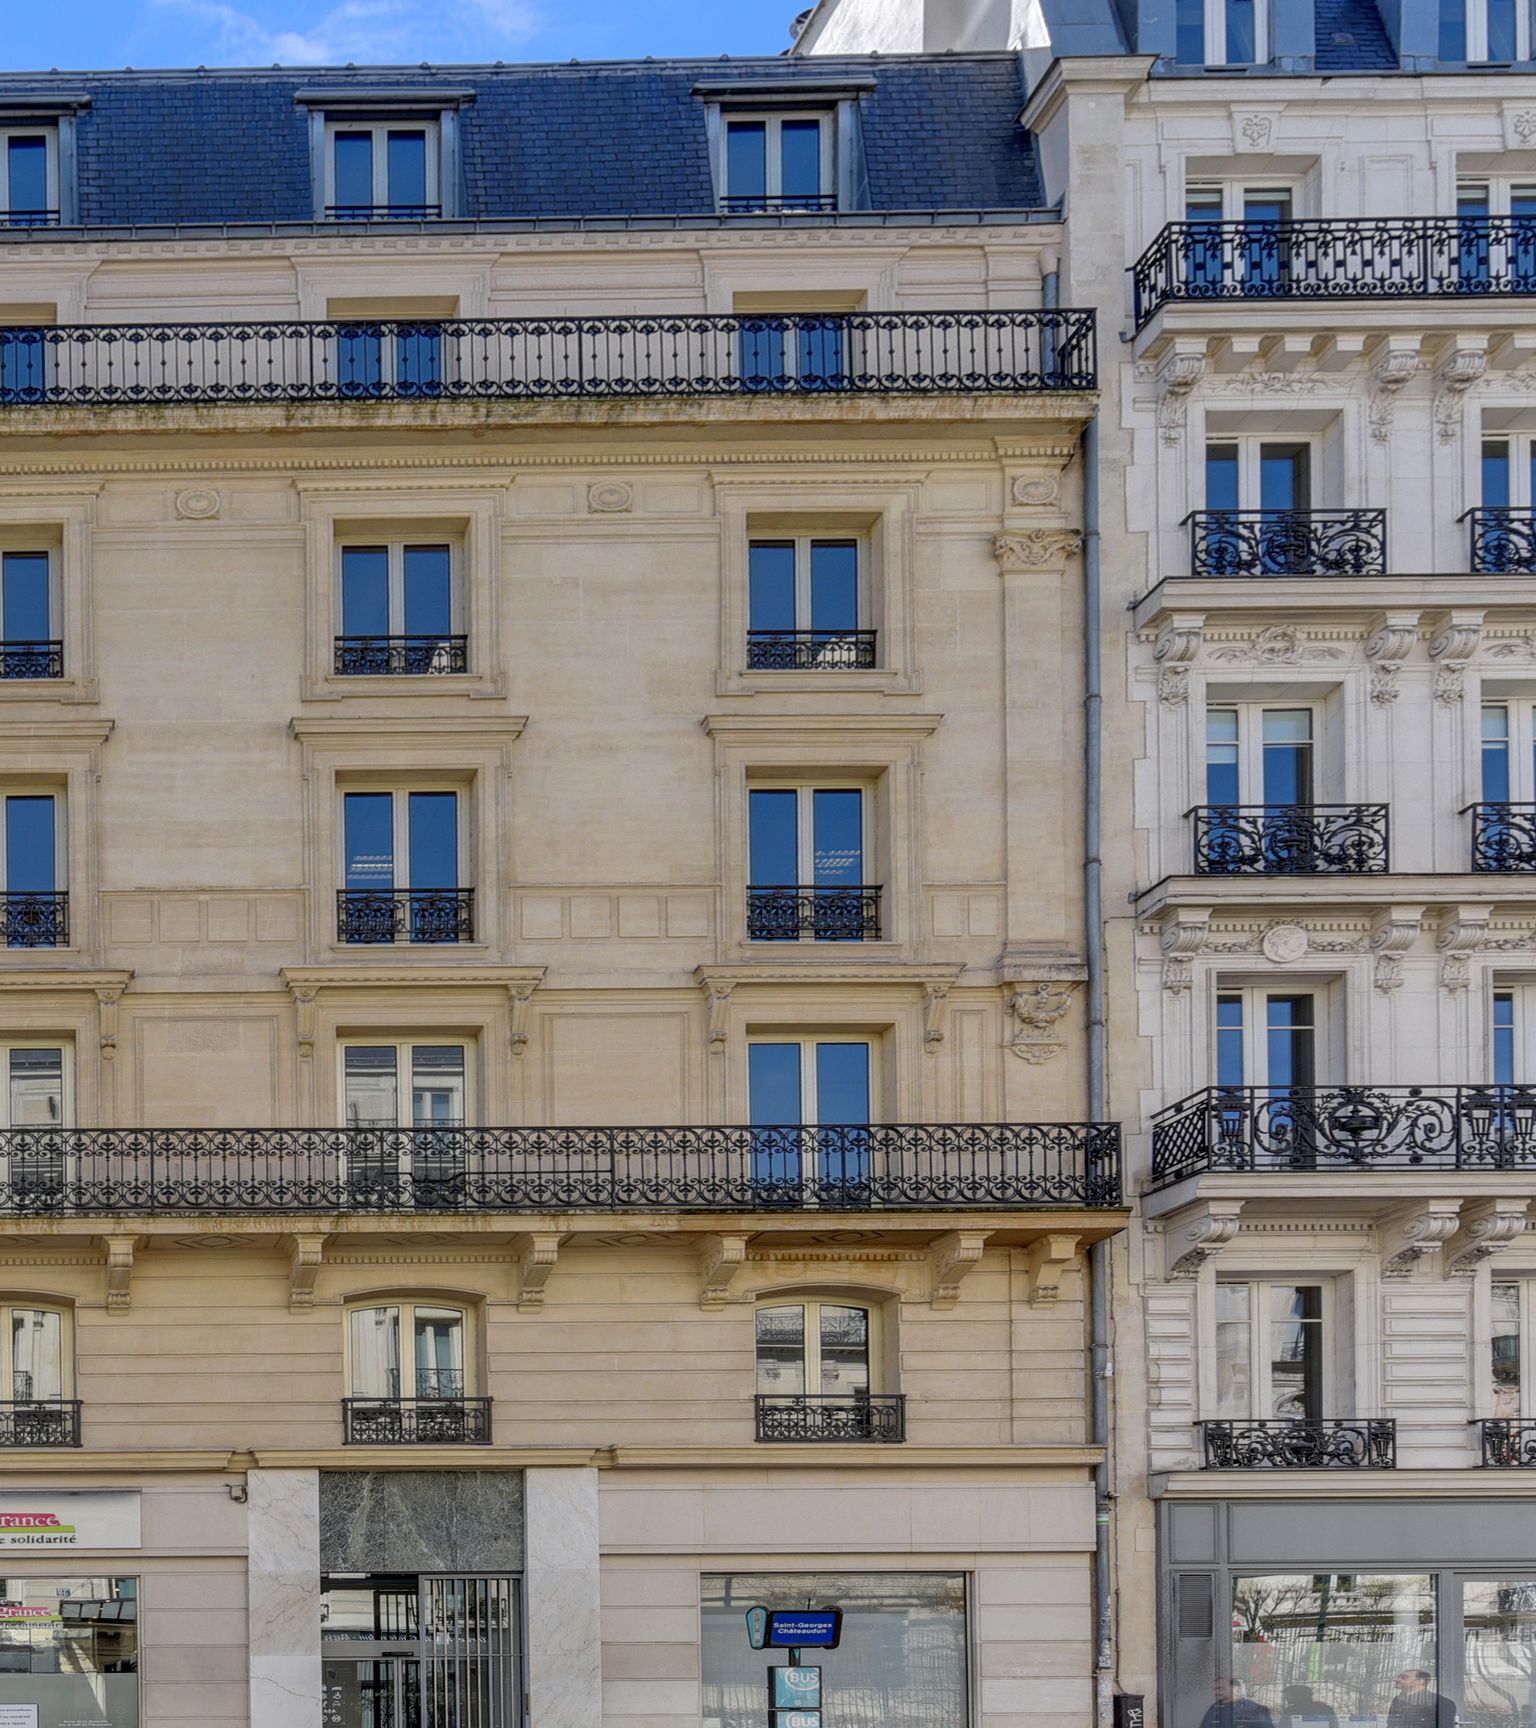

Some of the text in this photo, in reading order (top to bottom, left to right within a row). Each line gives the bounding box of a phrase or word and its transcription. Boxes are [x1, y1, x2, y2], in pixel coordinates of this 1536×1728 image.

[11, 1535, 76, 1544] solidarité
[790, 1672, 818, 1683] BUS
[791, 1716, 819, 1727] BUS
